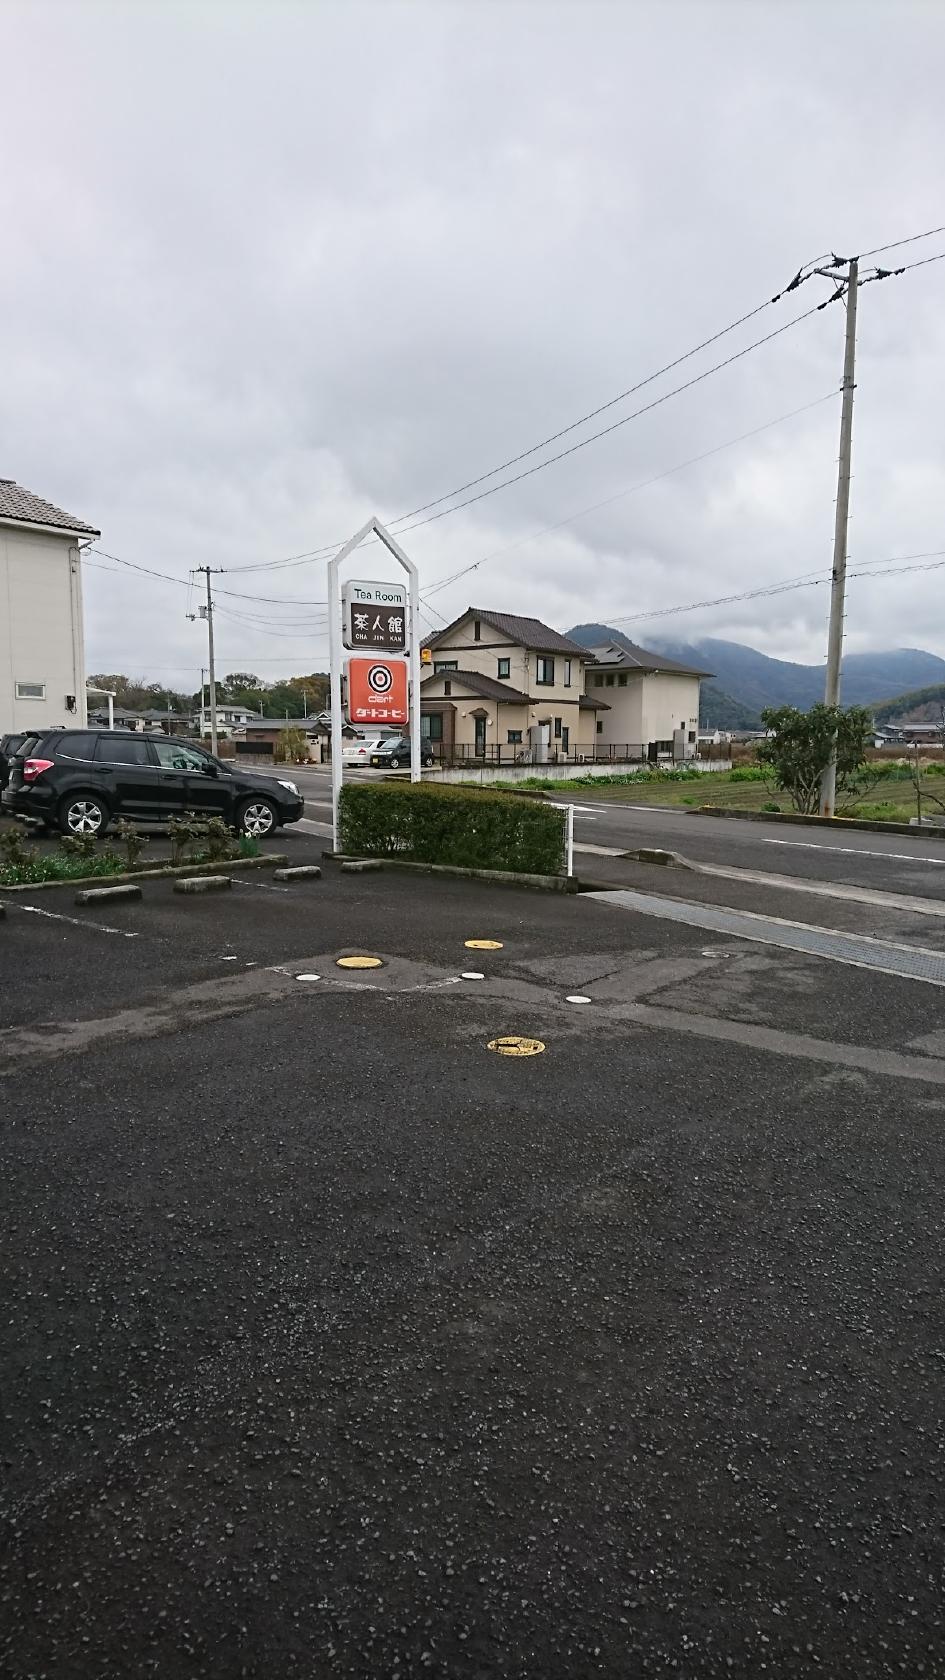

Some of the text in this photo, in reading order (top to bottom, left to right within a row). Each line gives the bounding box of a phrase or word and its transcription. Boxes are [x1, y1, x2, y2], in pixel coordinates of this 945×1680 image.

[354, 588, 402, 603] Tea Room
[354, 613, 403, 633] 茶人館
[356, 708, 405, 718] ダートコーヒー
